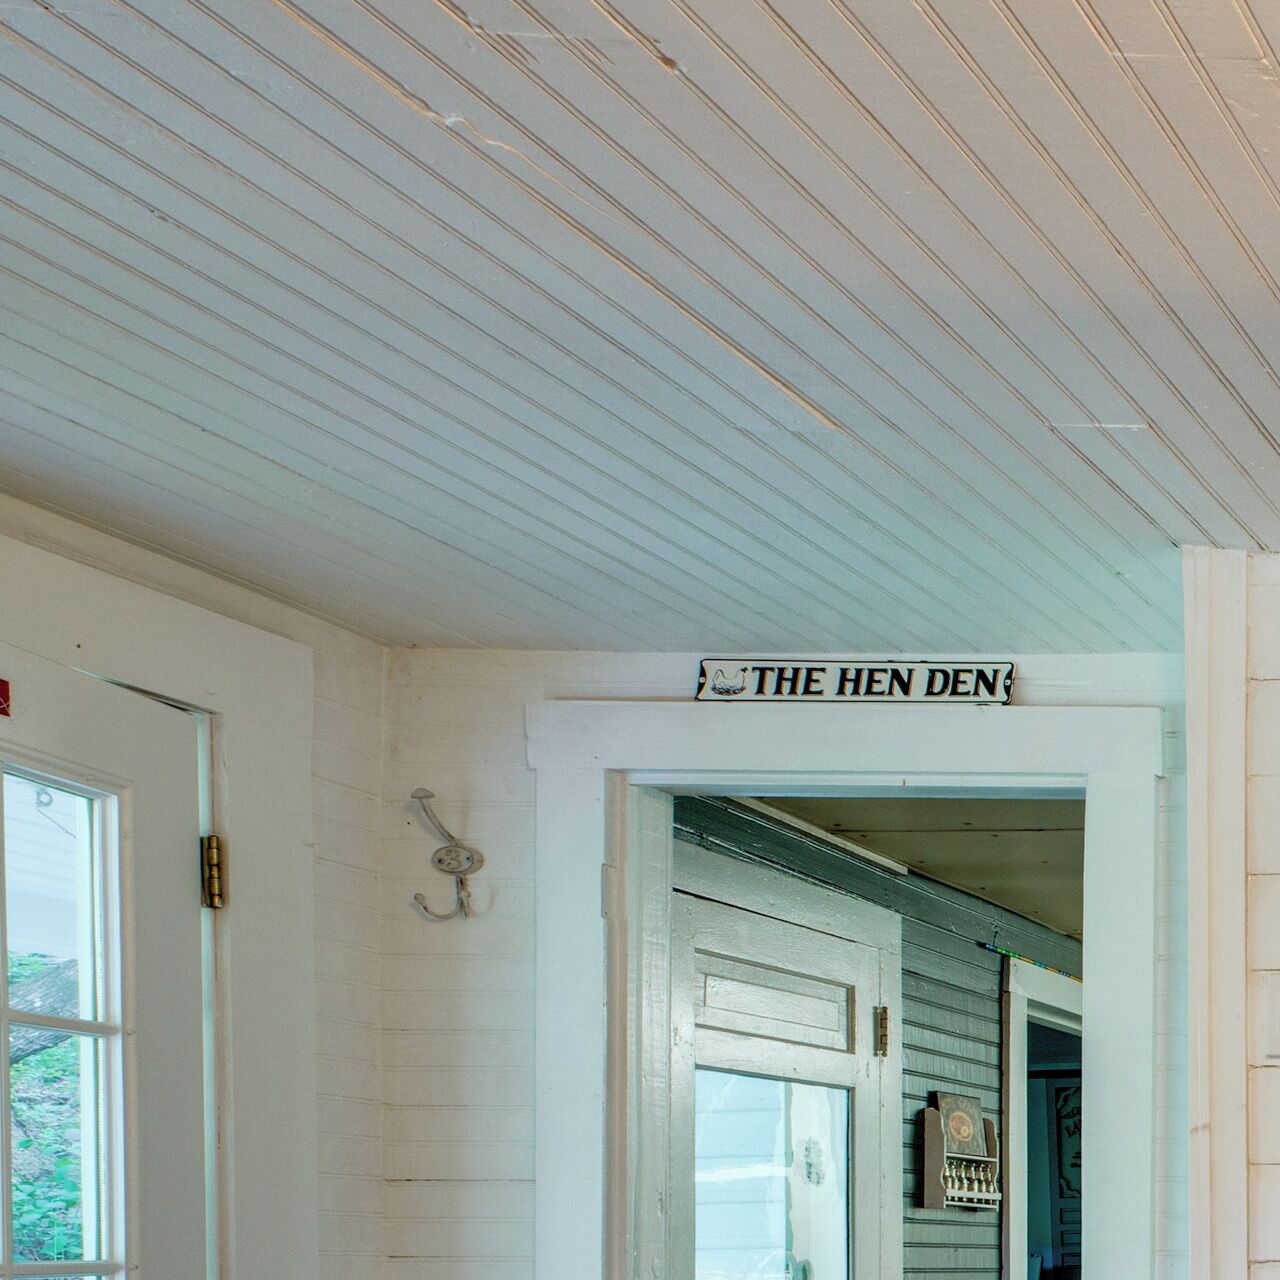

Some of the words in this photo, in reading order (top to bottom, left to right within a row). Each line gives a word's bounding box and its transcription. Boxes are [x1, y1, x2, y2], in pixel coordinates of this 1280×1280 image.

[752, 666, 826, 695] THE
[836, 667, 916, 696] HEN
[924, 668, 1000, 697] DEN
[445, 849, 463, 870] 3
